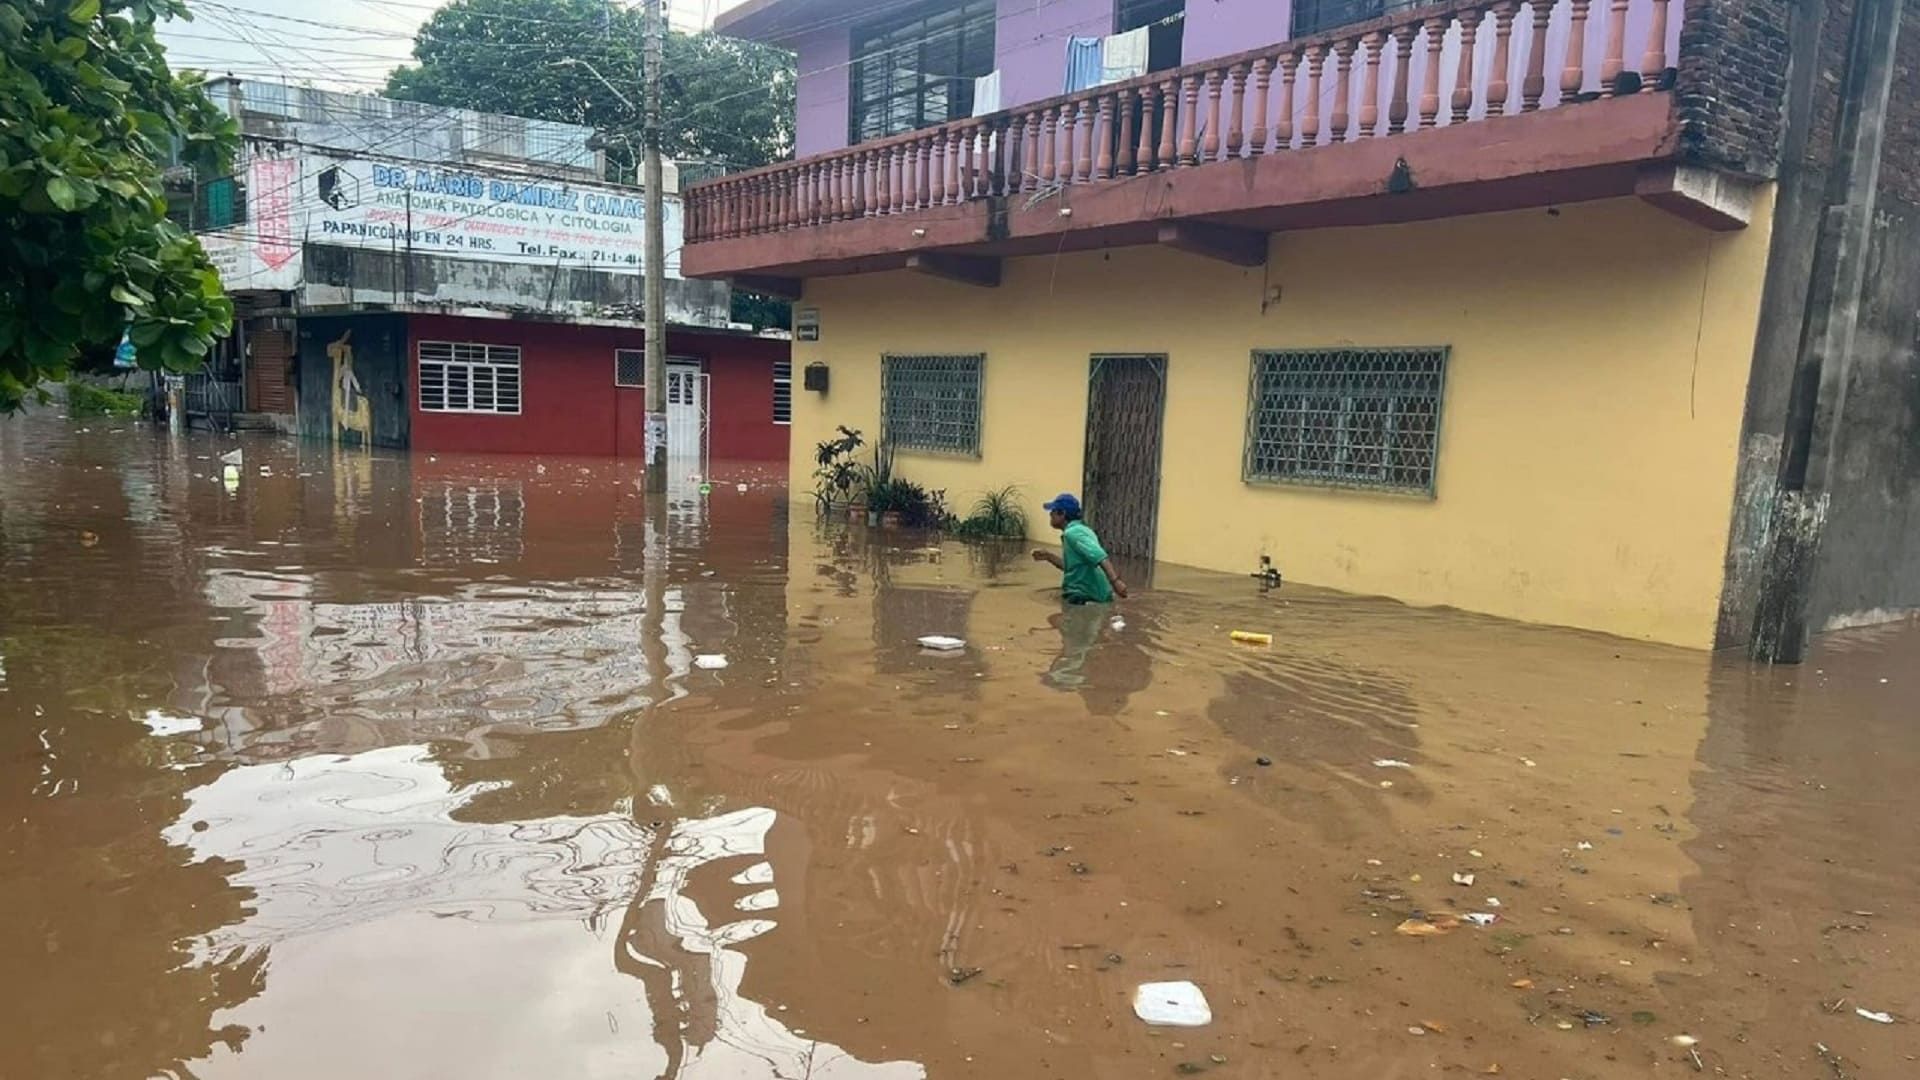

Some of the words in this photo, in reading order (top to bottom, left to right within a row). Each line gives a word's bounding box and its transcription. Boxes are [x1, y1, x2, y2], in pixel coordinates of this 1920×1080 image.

[414, 169, 484, 199] MARIO
[545, 211, 555, 225] Y
[561, 214, 633, 234] CITOLOGIA
[425, 231, 441, 245] EN
[446, 234, 464, 248] 24
[469, 236, 496, 251] HRS.
